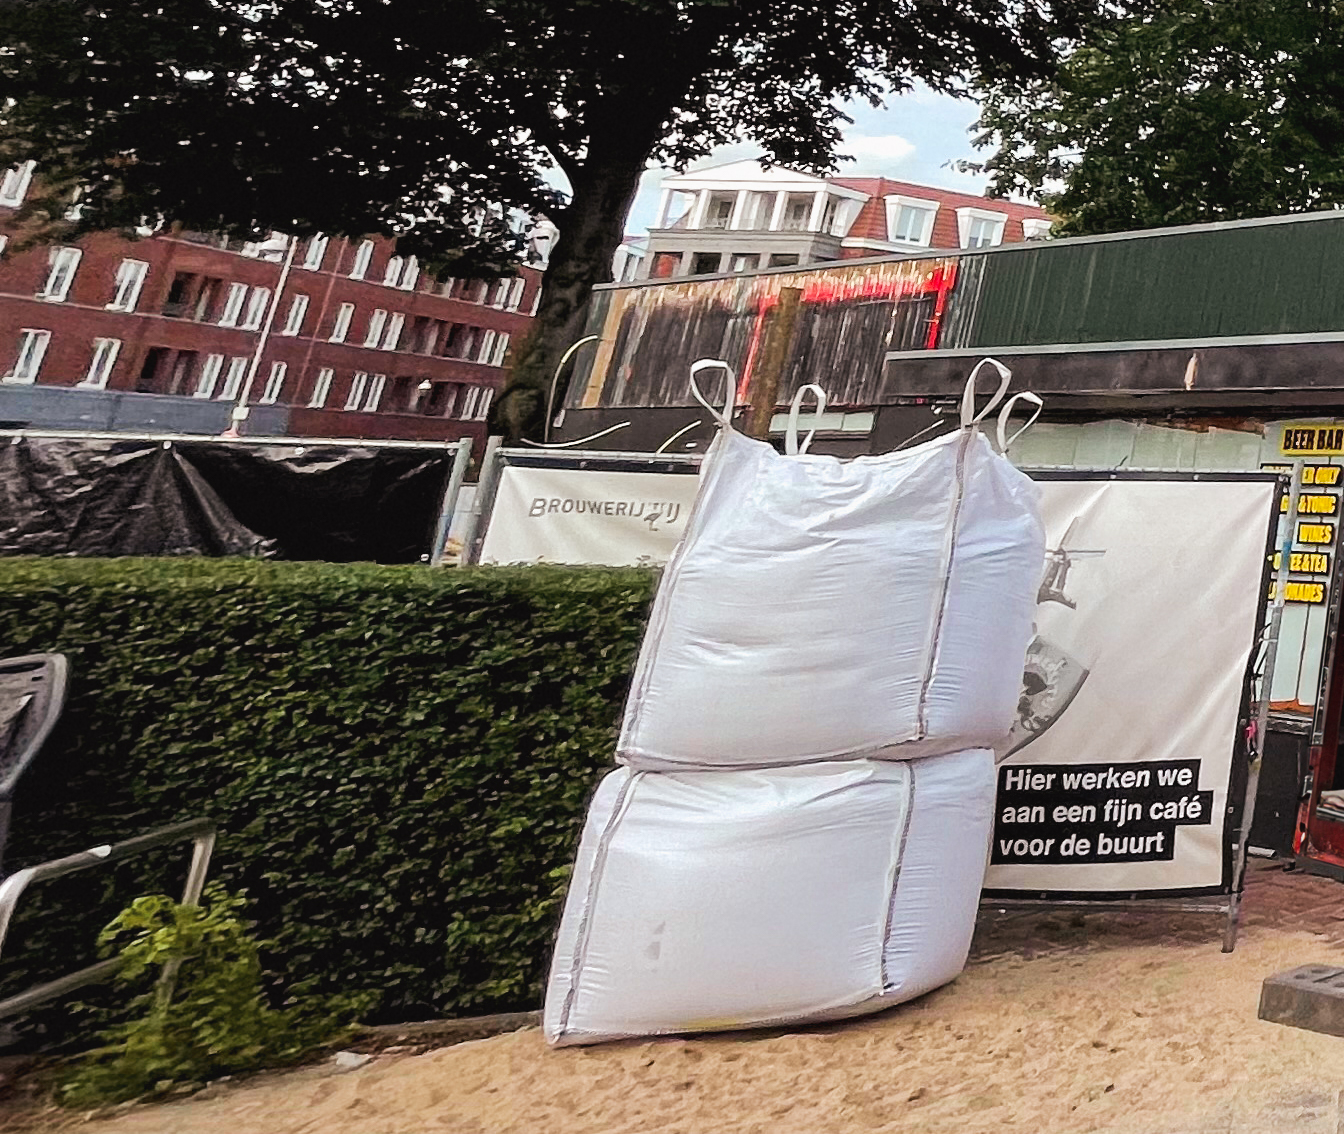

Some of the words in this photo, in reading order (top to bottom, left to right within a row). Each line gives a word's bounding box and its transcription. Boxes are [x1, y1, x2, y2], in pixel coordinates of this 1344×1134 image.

[1283, 429, 1316, 450] BEER
[1316, 429, 1344, 450] BAR
[1299, 523, 1333, 544] WINES
[1005, 768, 1057, 791] Hier
[1062, 767, 1151, 791] werken
[1157, 767, 1194, 787] we
[1001, 805, 1046, 824] aan
[1052, 805, 1097, 823] een
[1103, 798, 1143, 828] fijn
[1149, 794, 1203, 821] café
[999, 838, 1056, 856] voor
[1059, 833, 1092, 856] de
[1097, 831, 1166, 856] buurt
